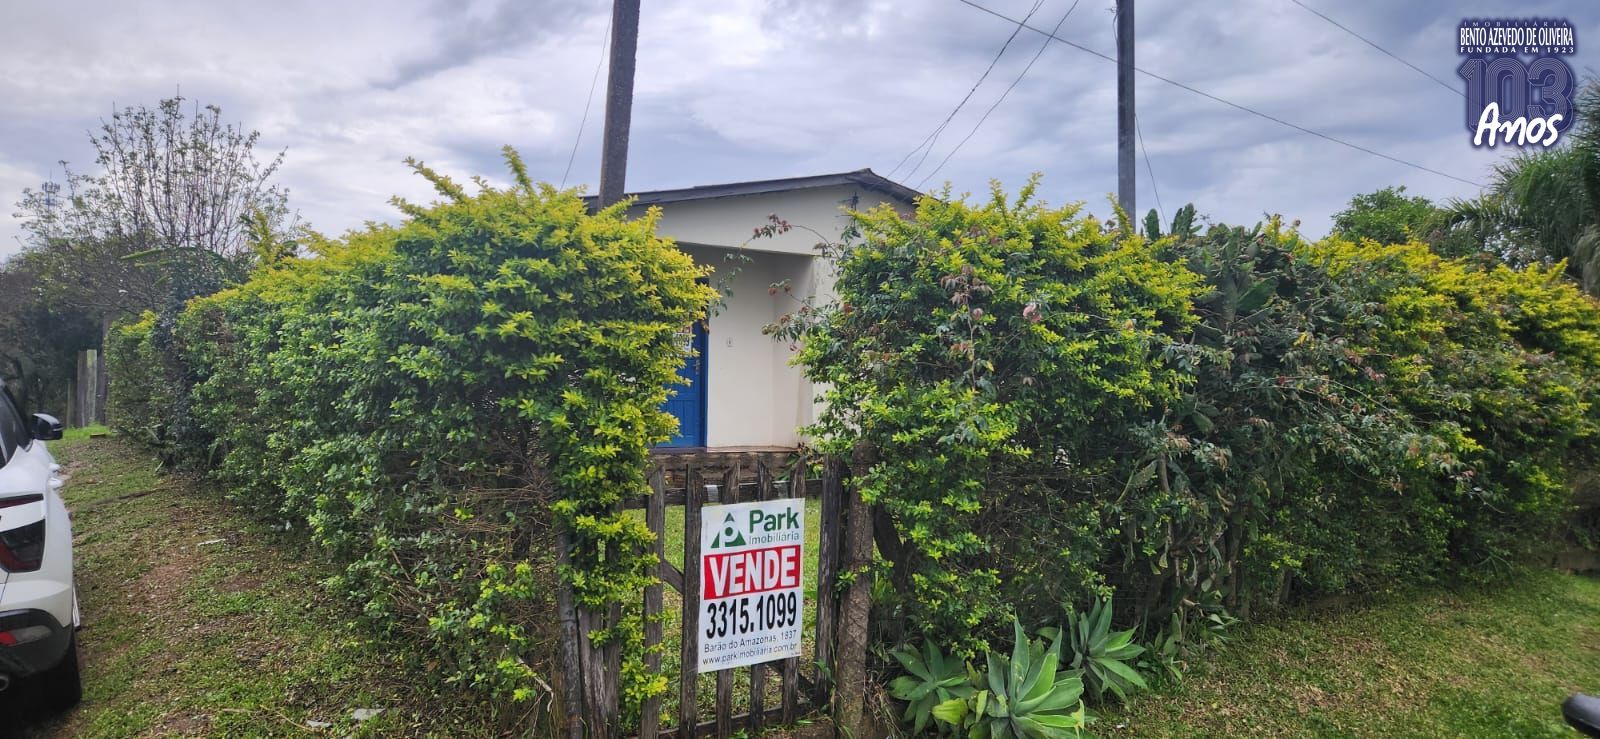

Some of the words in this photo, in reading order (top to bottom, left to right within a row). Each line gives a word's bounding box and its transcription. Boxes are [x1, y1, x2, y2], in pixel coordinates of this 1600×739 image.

[749, 507, 799, 533] Park
[709, 549, 796, 597] VENDE
[706, 592, 797, 639] 3315.1099
[704, 642, 727, 653] Barão
[728, 639, 738, 649] do
